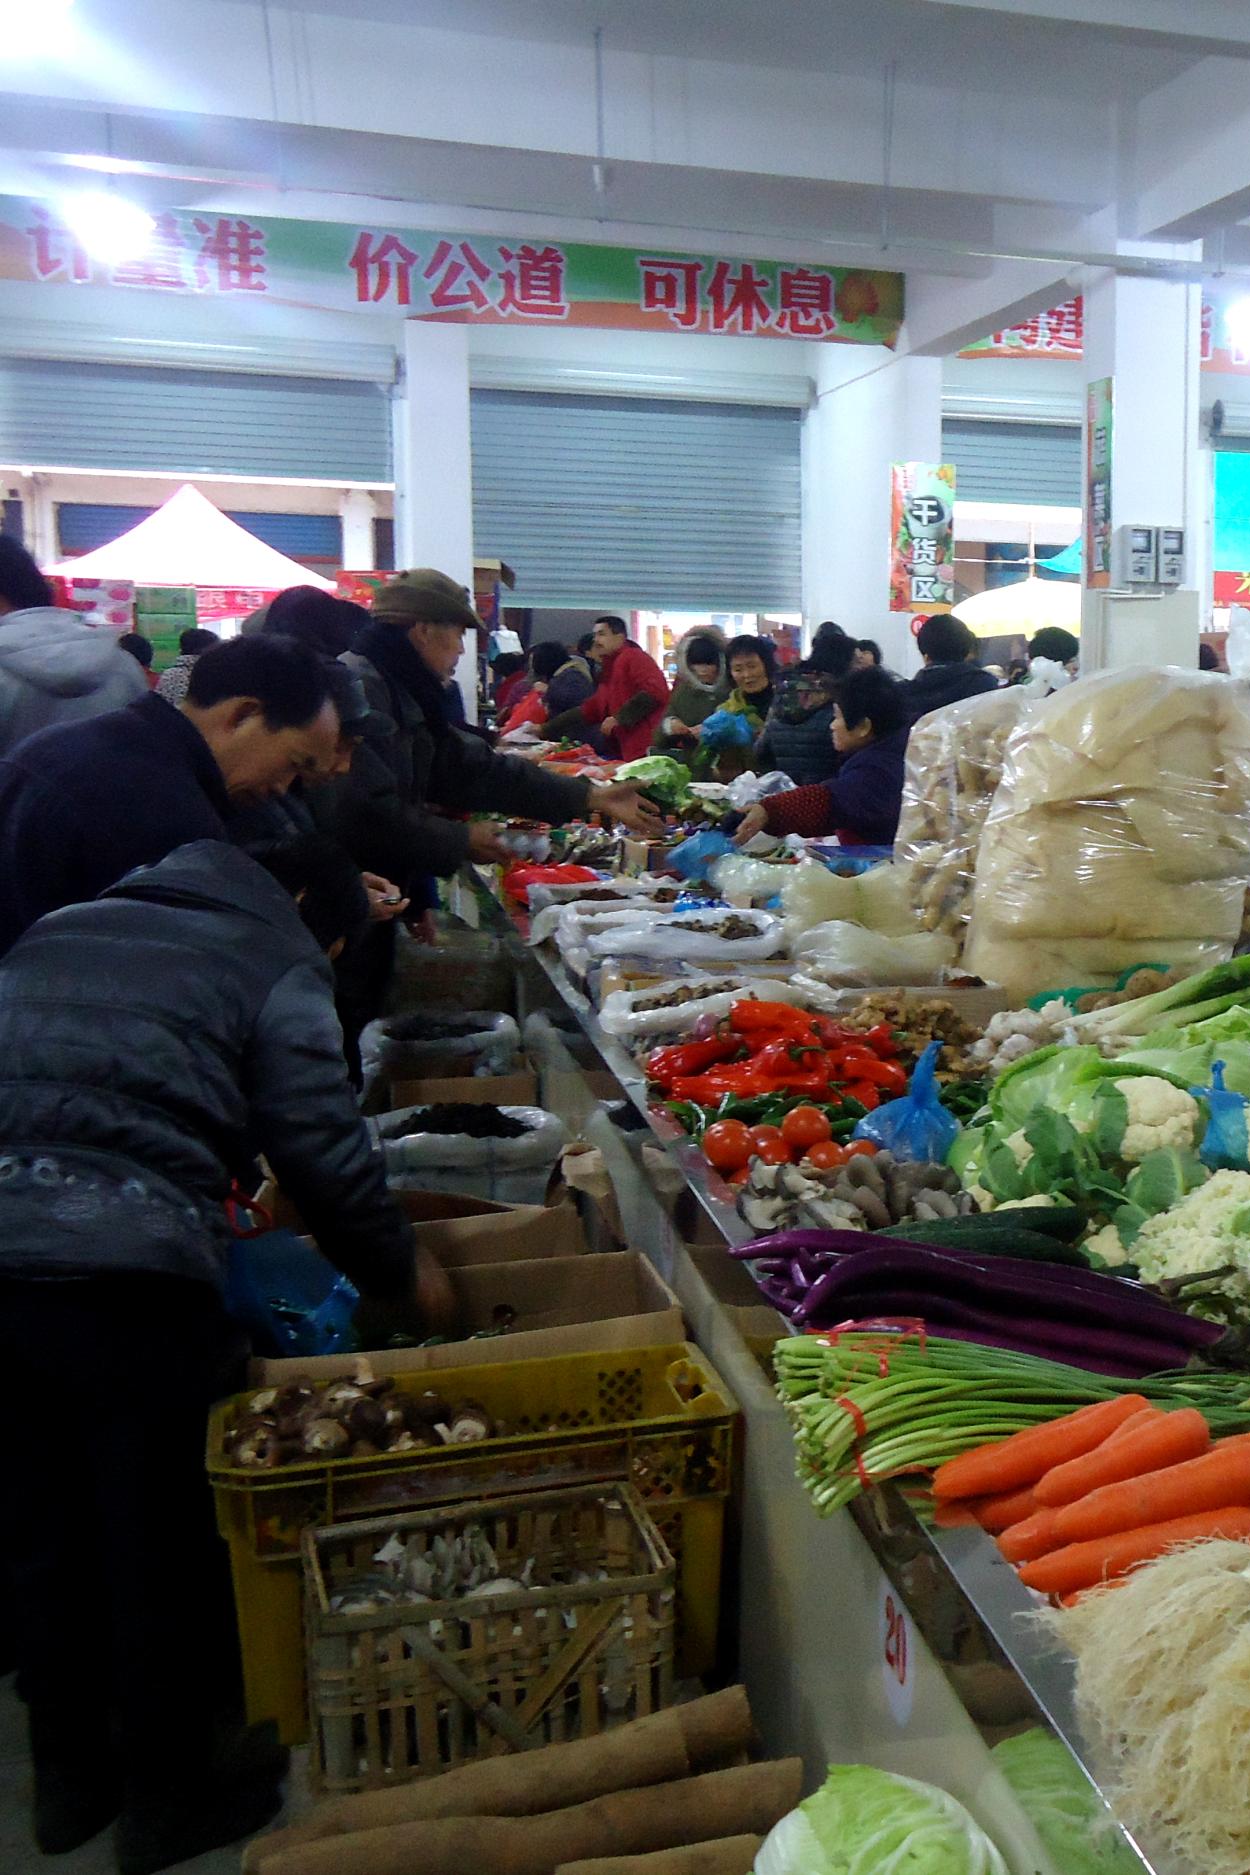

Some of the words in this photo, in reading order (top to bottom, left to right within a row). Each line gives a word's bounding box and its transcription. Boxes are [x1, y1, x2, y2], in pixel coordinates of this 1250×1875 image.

[346, 231, 569, 319] 价公道
[638, 258, 836, 336] 可休息
[911, 499, 939, 603] 干货区
